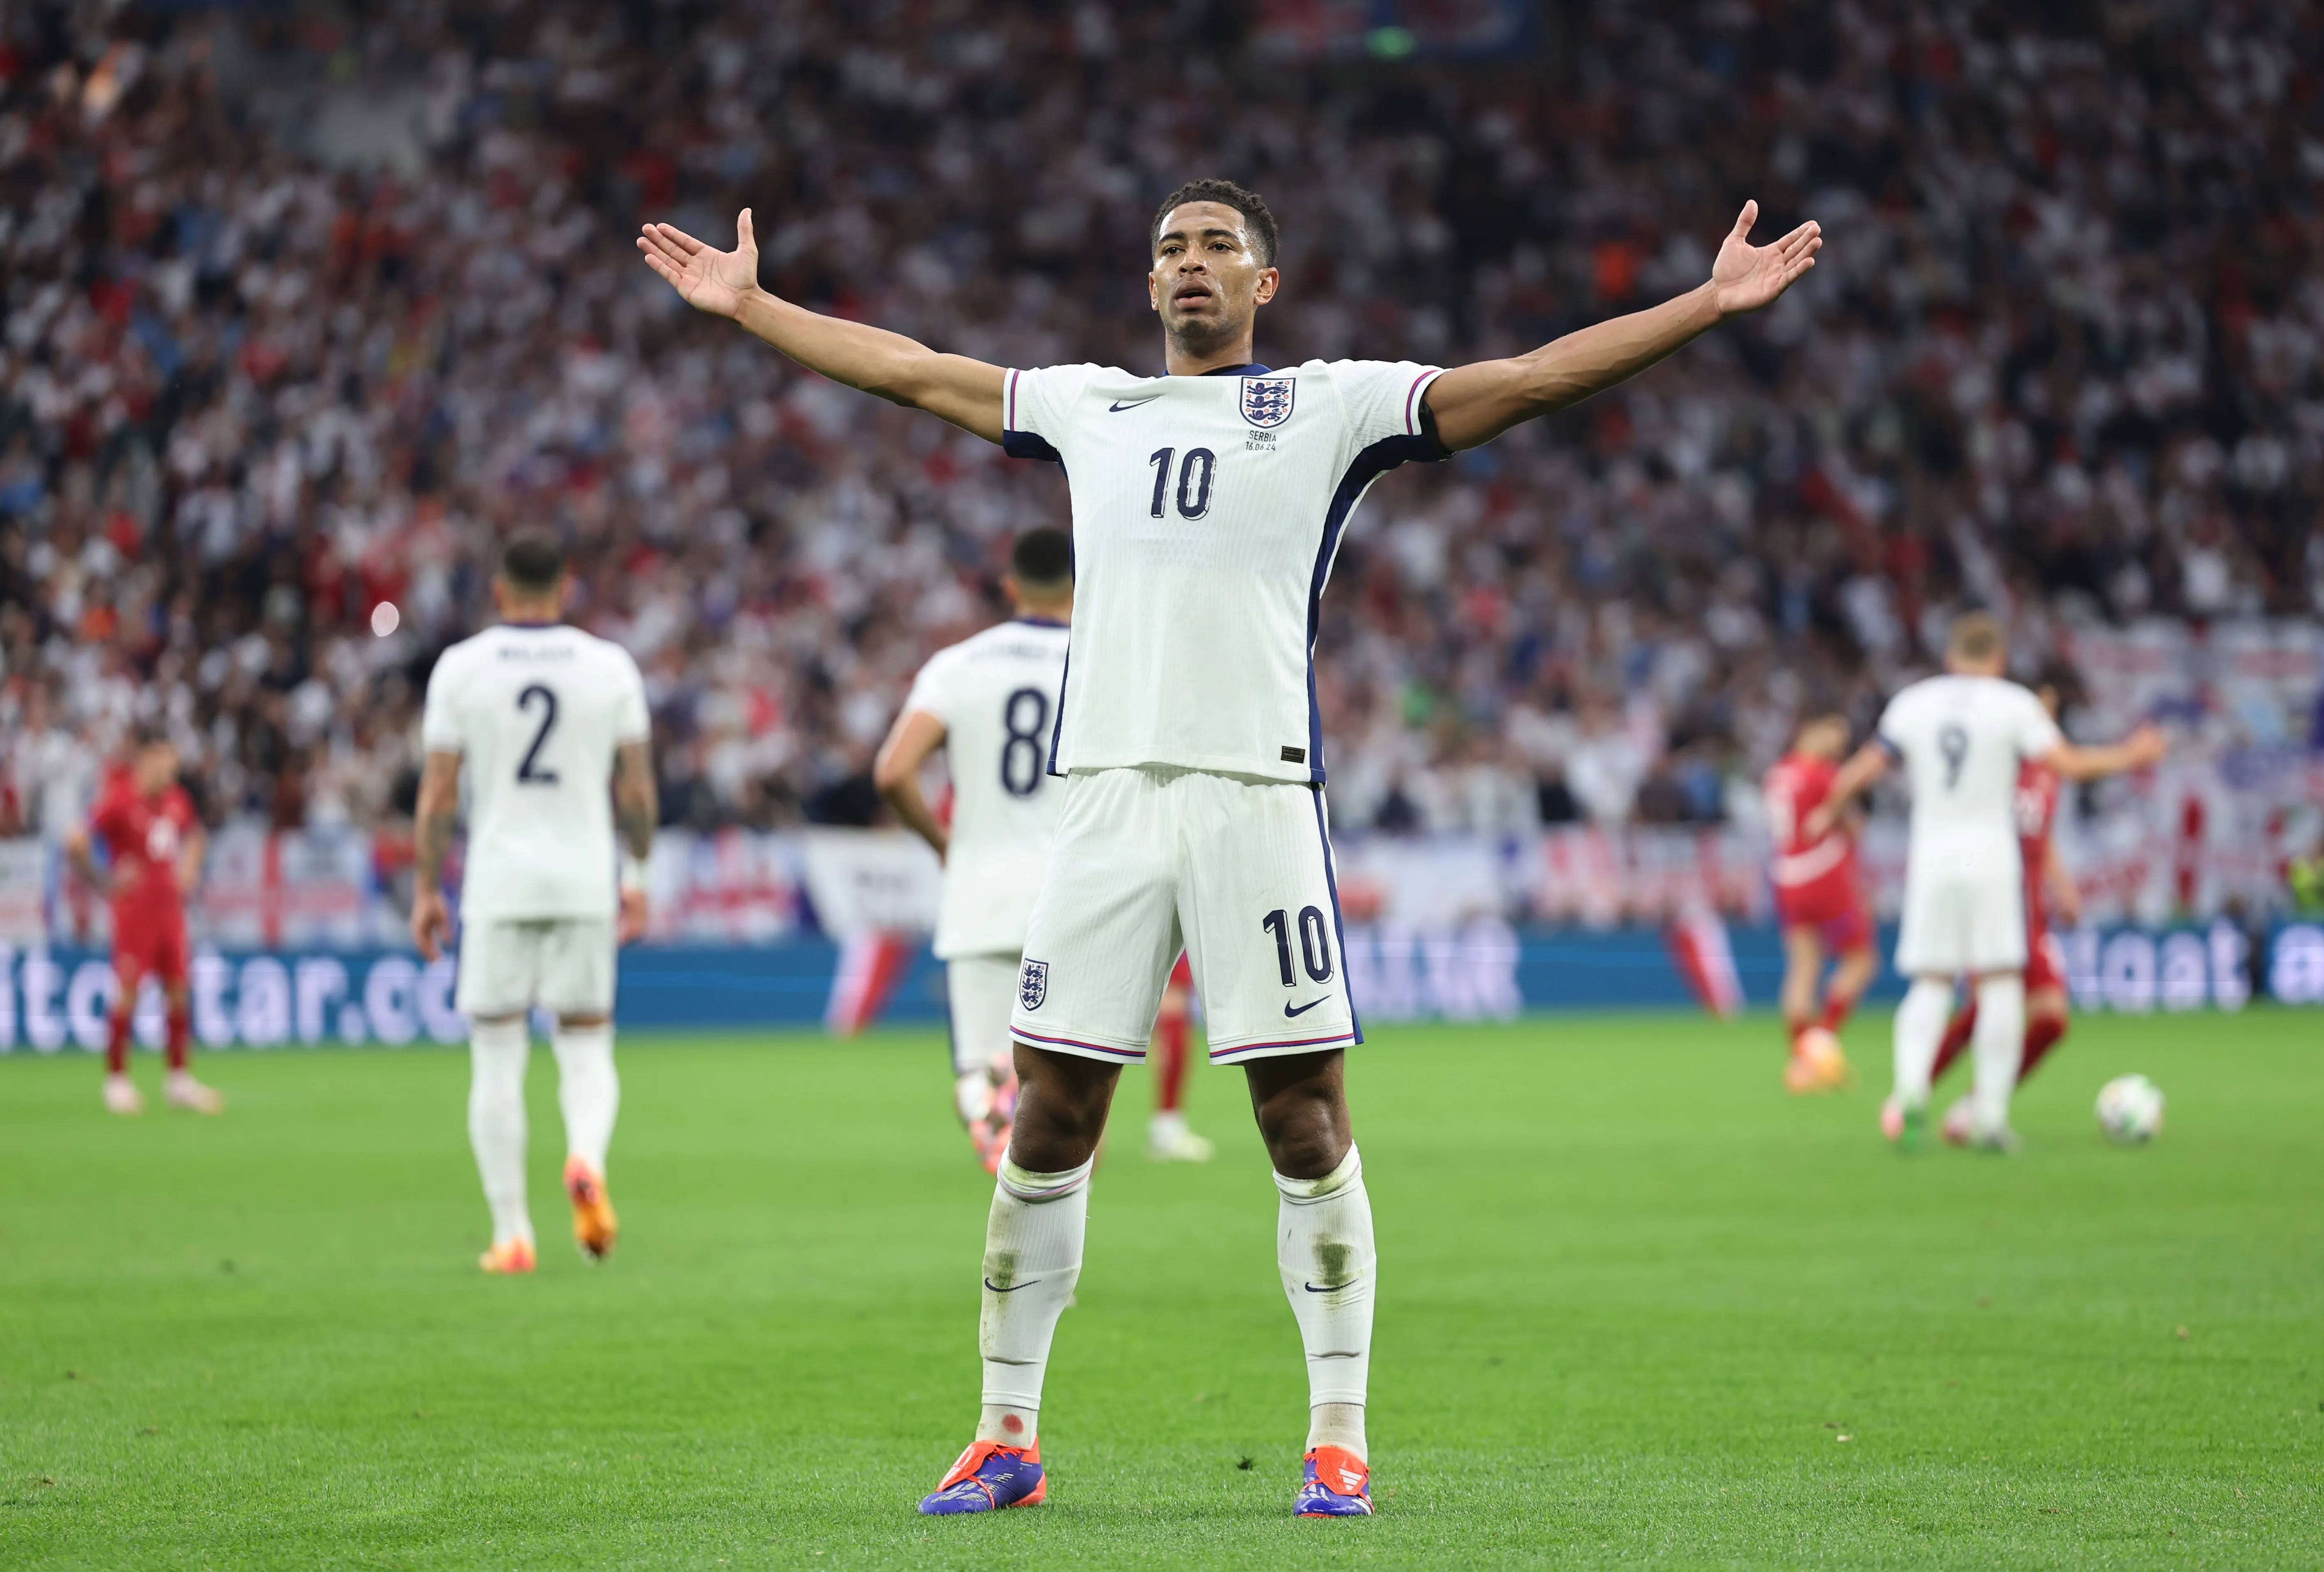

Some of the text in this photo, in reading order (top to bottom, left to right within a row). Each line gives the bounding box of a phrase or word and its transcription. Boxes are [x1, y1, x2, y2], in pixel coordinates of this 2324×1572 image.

[1246, 441, 1276, 451] 16.06.24
[1249, 430, 1276, 442] SERBIA
[1150, 447, 1216, 521] 10
[517, 683, 559, 784] 2
[1001, 686, 1049, 798] 8
[1938, 722, 1970, 794] 9
[1263, 905, 1334, 987] 10
